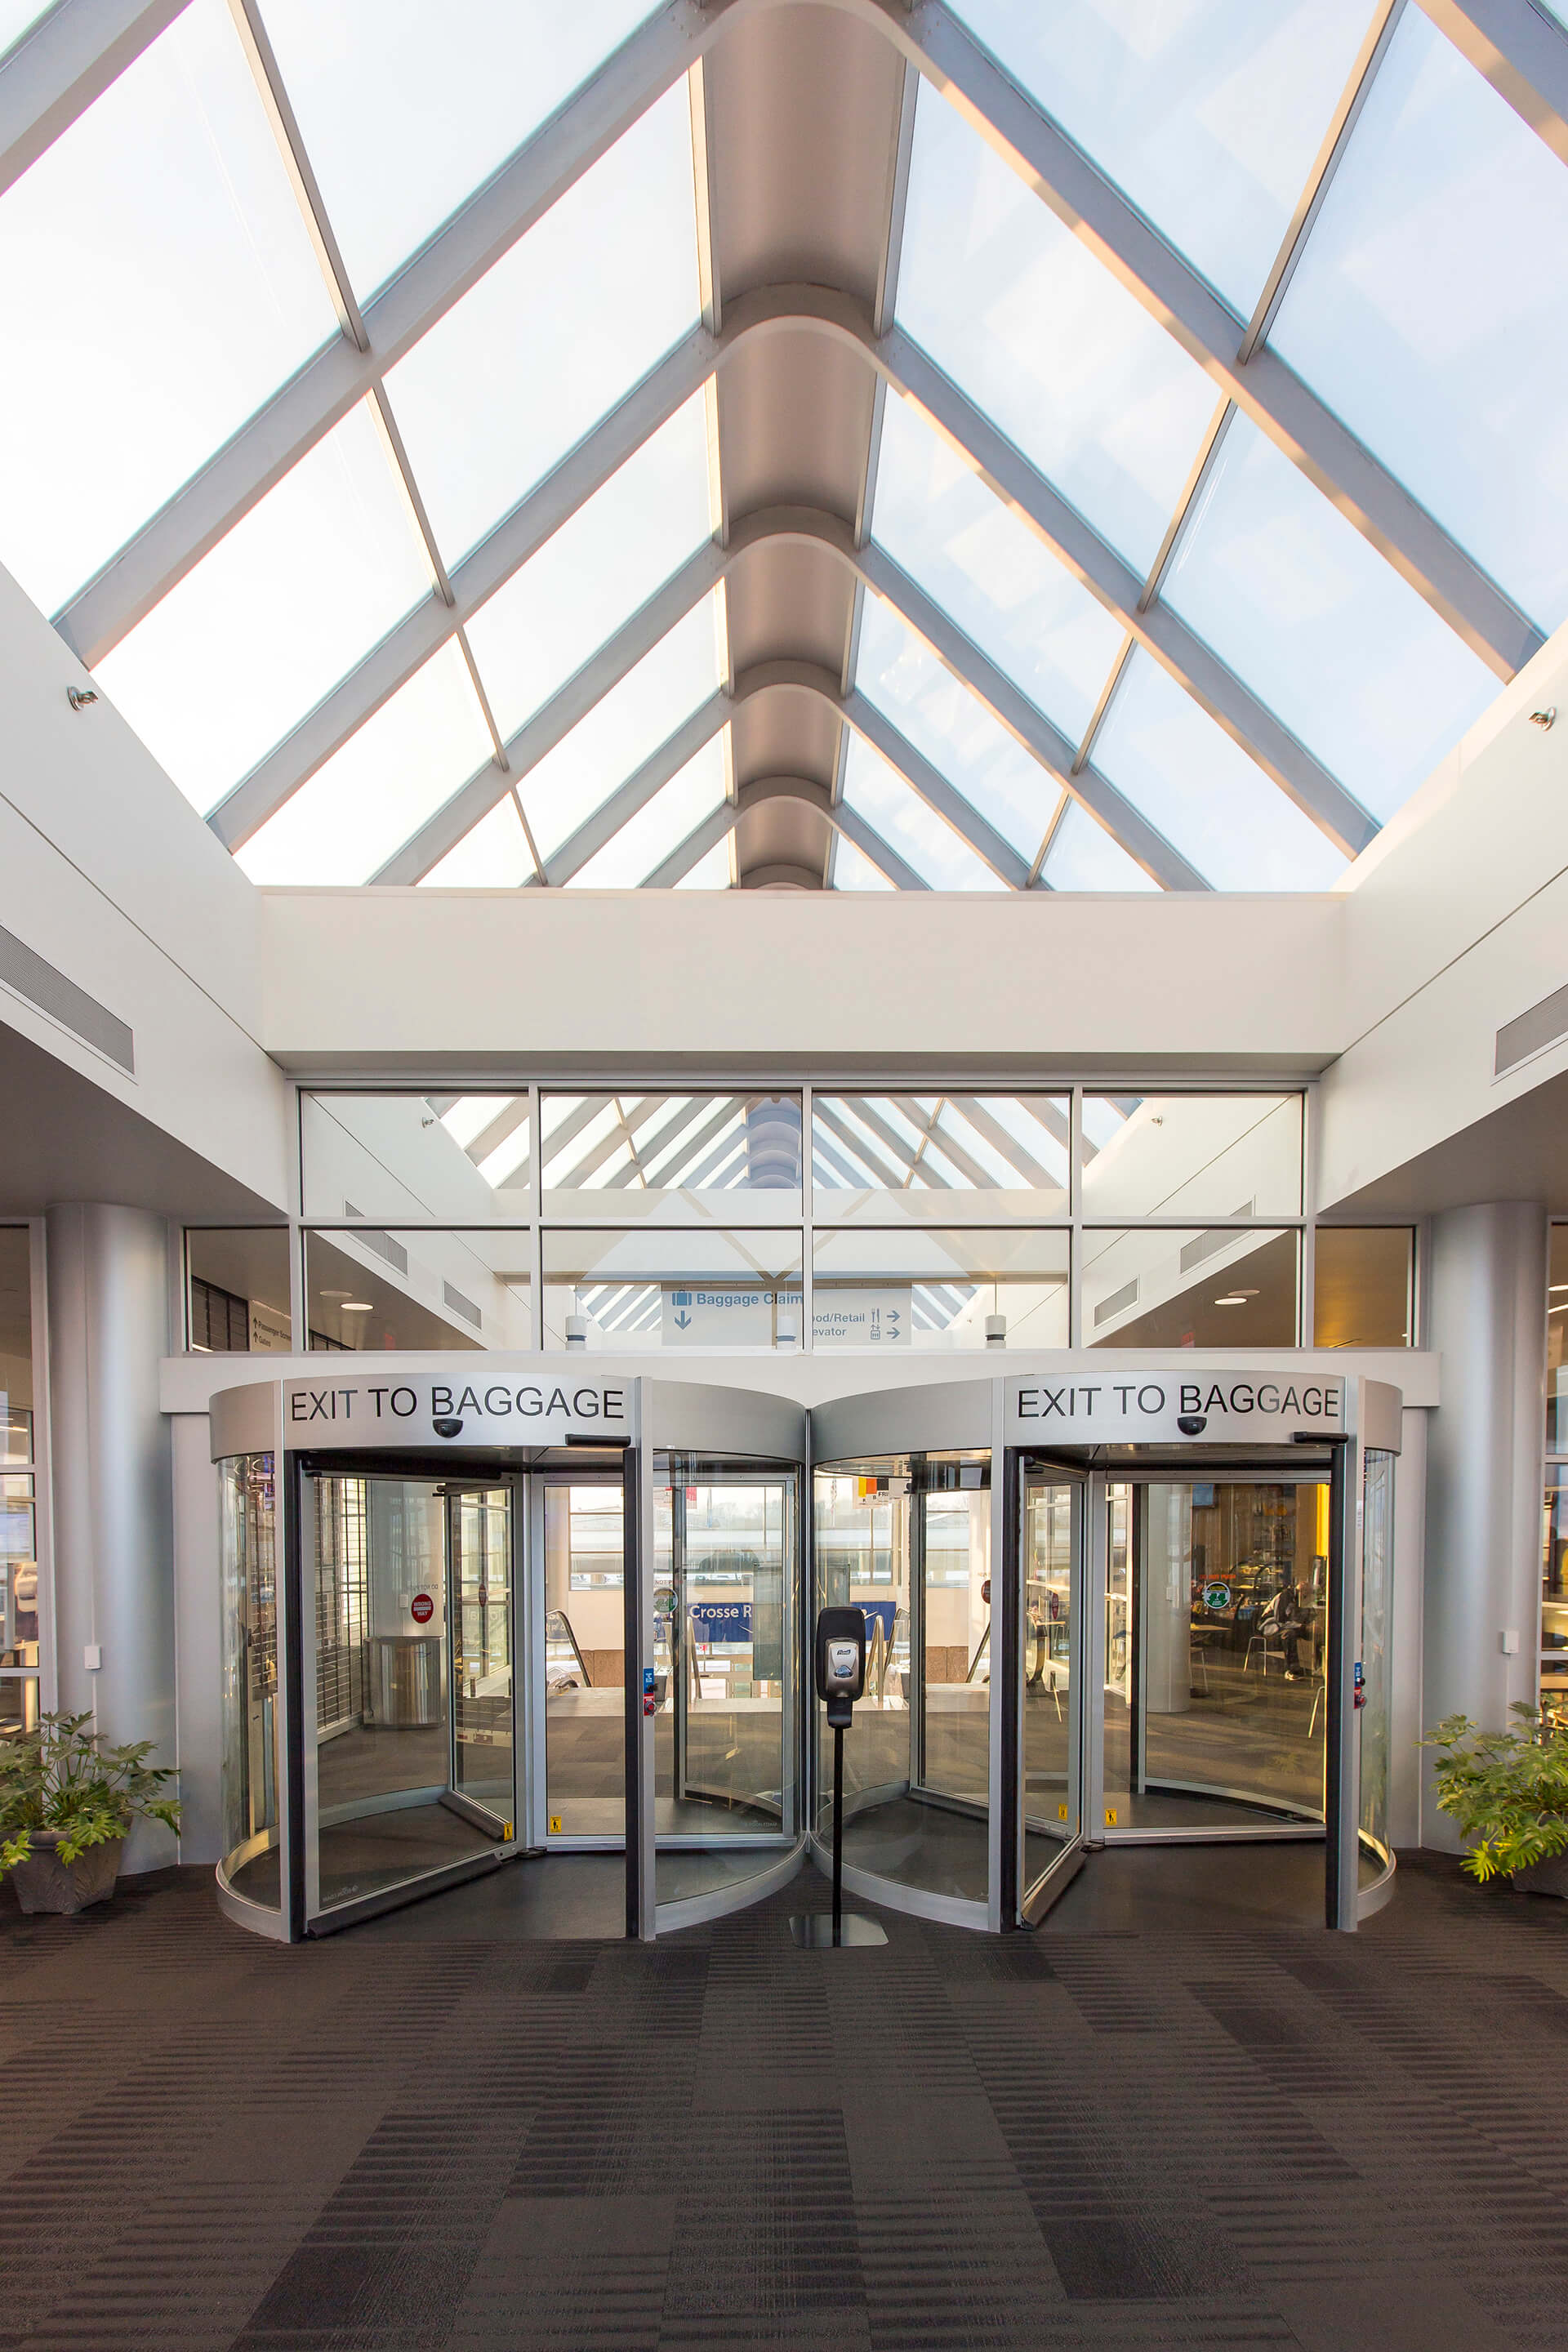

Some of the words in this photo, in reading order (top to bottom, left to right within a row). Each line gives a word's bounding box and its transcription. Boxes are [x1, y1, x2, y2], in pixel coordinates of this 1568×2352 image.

[697, 1293, 759, 1307] Baggage
[764, 1293, 804, 1305] Claim
[813, 1312, 865, 1323] od/Retail
[813, 1327, 847, 1336] evator
[292, 1389, 358, 1421] EXIT
[368, 1388, 417, 1417] TO
[431, 1386, 624, 1419] BAGGAGE
[1018, 1388, 1102, 1418] EXIT
[1113, 1384, 1165, 1414] TO
[1180, 1384, 1339, 1417] BAGGAGE
[689, 1605, 739, 1619] Crosse
